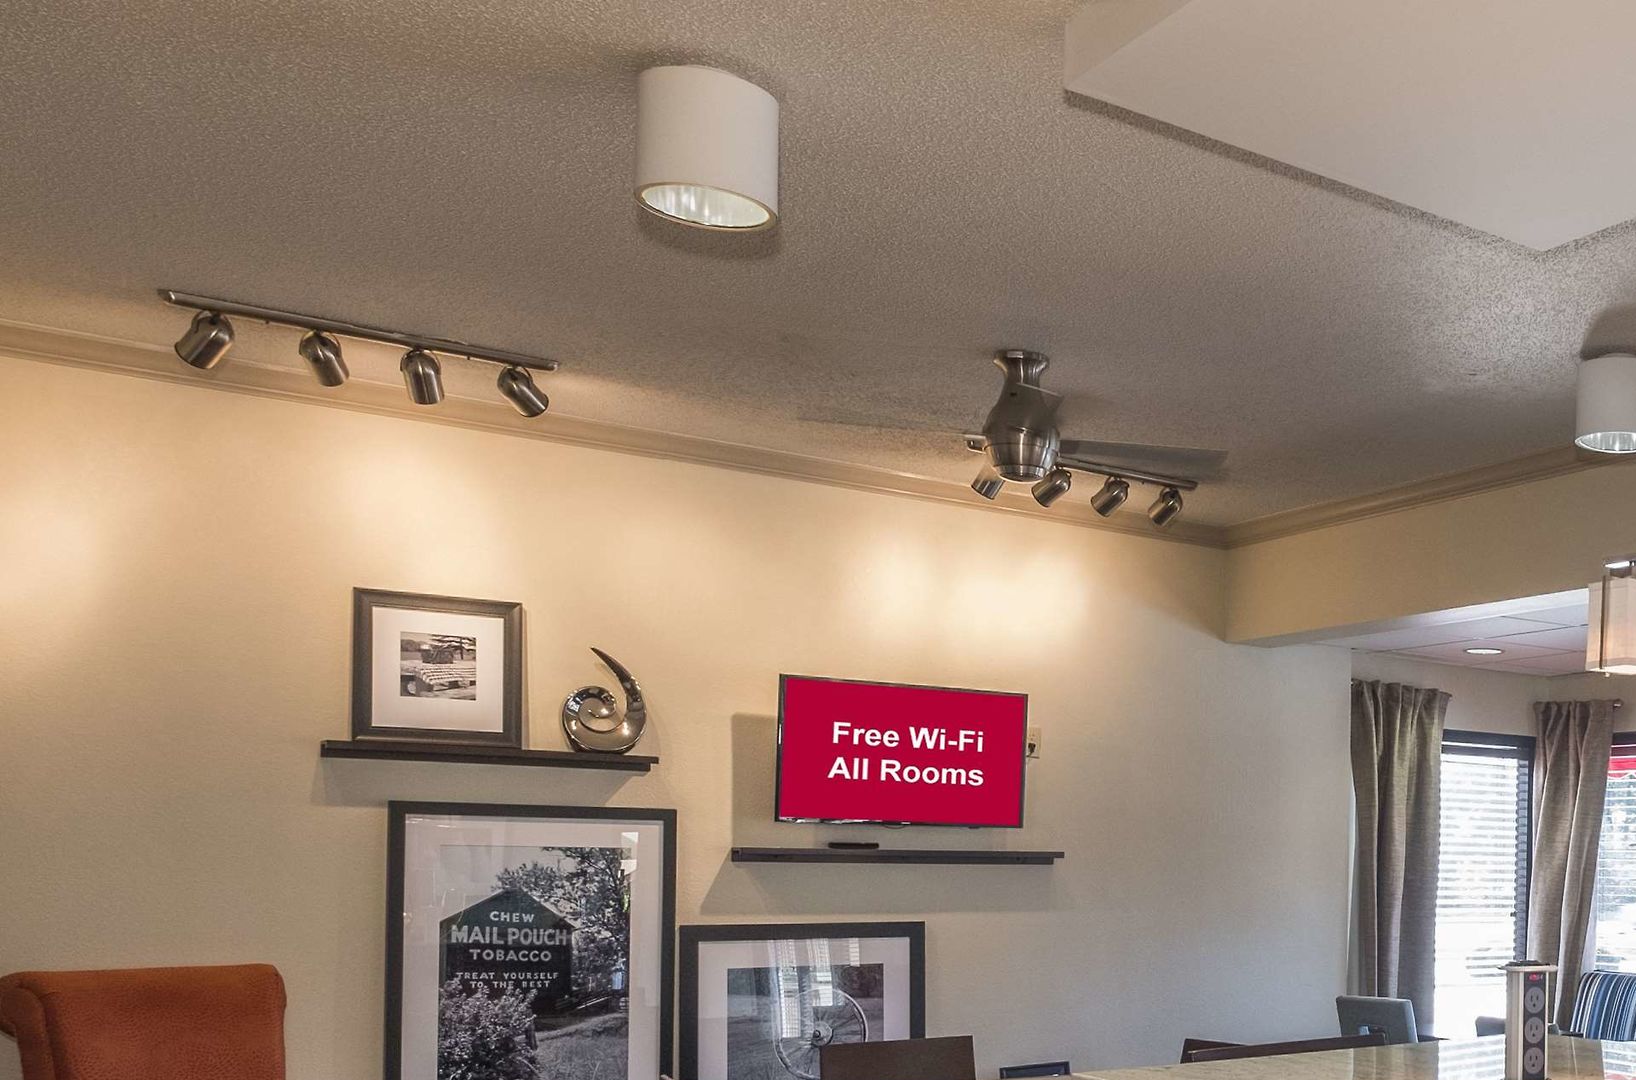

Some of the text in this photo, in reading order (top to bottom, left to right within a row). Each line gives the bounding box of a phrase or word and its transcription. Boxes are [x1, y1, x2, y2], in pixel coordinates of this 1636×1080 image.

[832, 721, 985, 753] Free Wi-Fi
[827, 756, 985, 787] All Rooms
[489, 910, 535, 923] CHEW
[450, 924, 568, 946] MAIL POUCH
[468, 948, 552, 962] TOBACCO
[455, 972, 560, 980] TREAT YOURSELF
[469, 981, 485, 989] TO
[493, 981, 515, 989] THE
